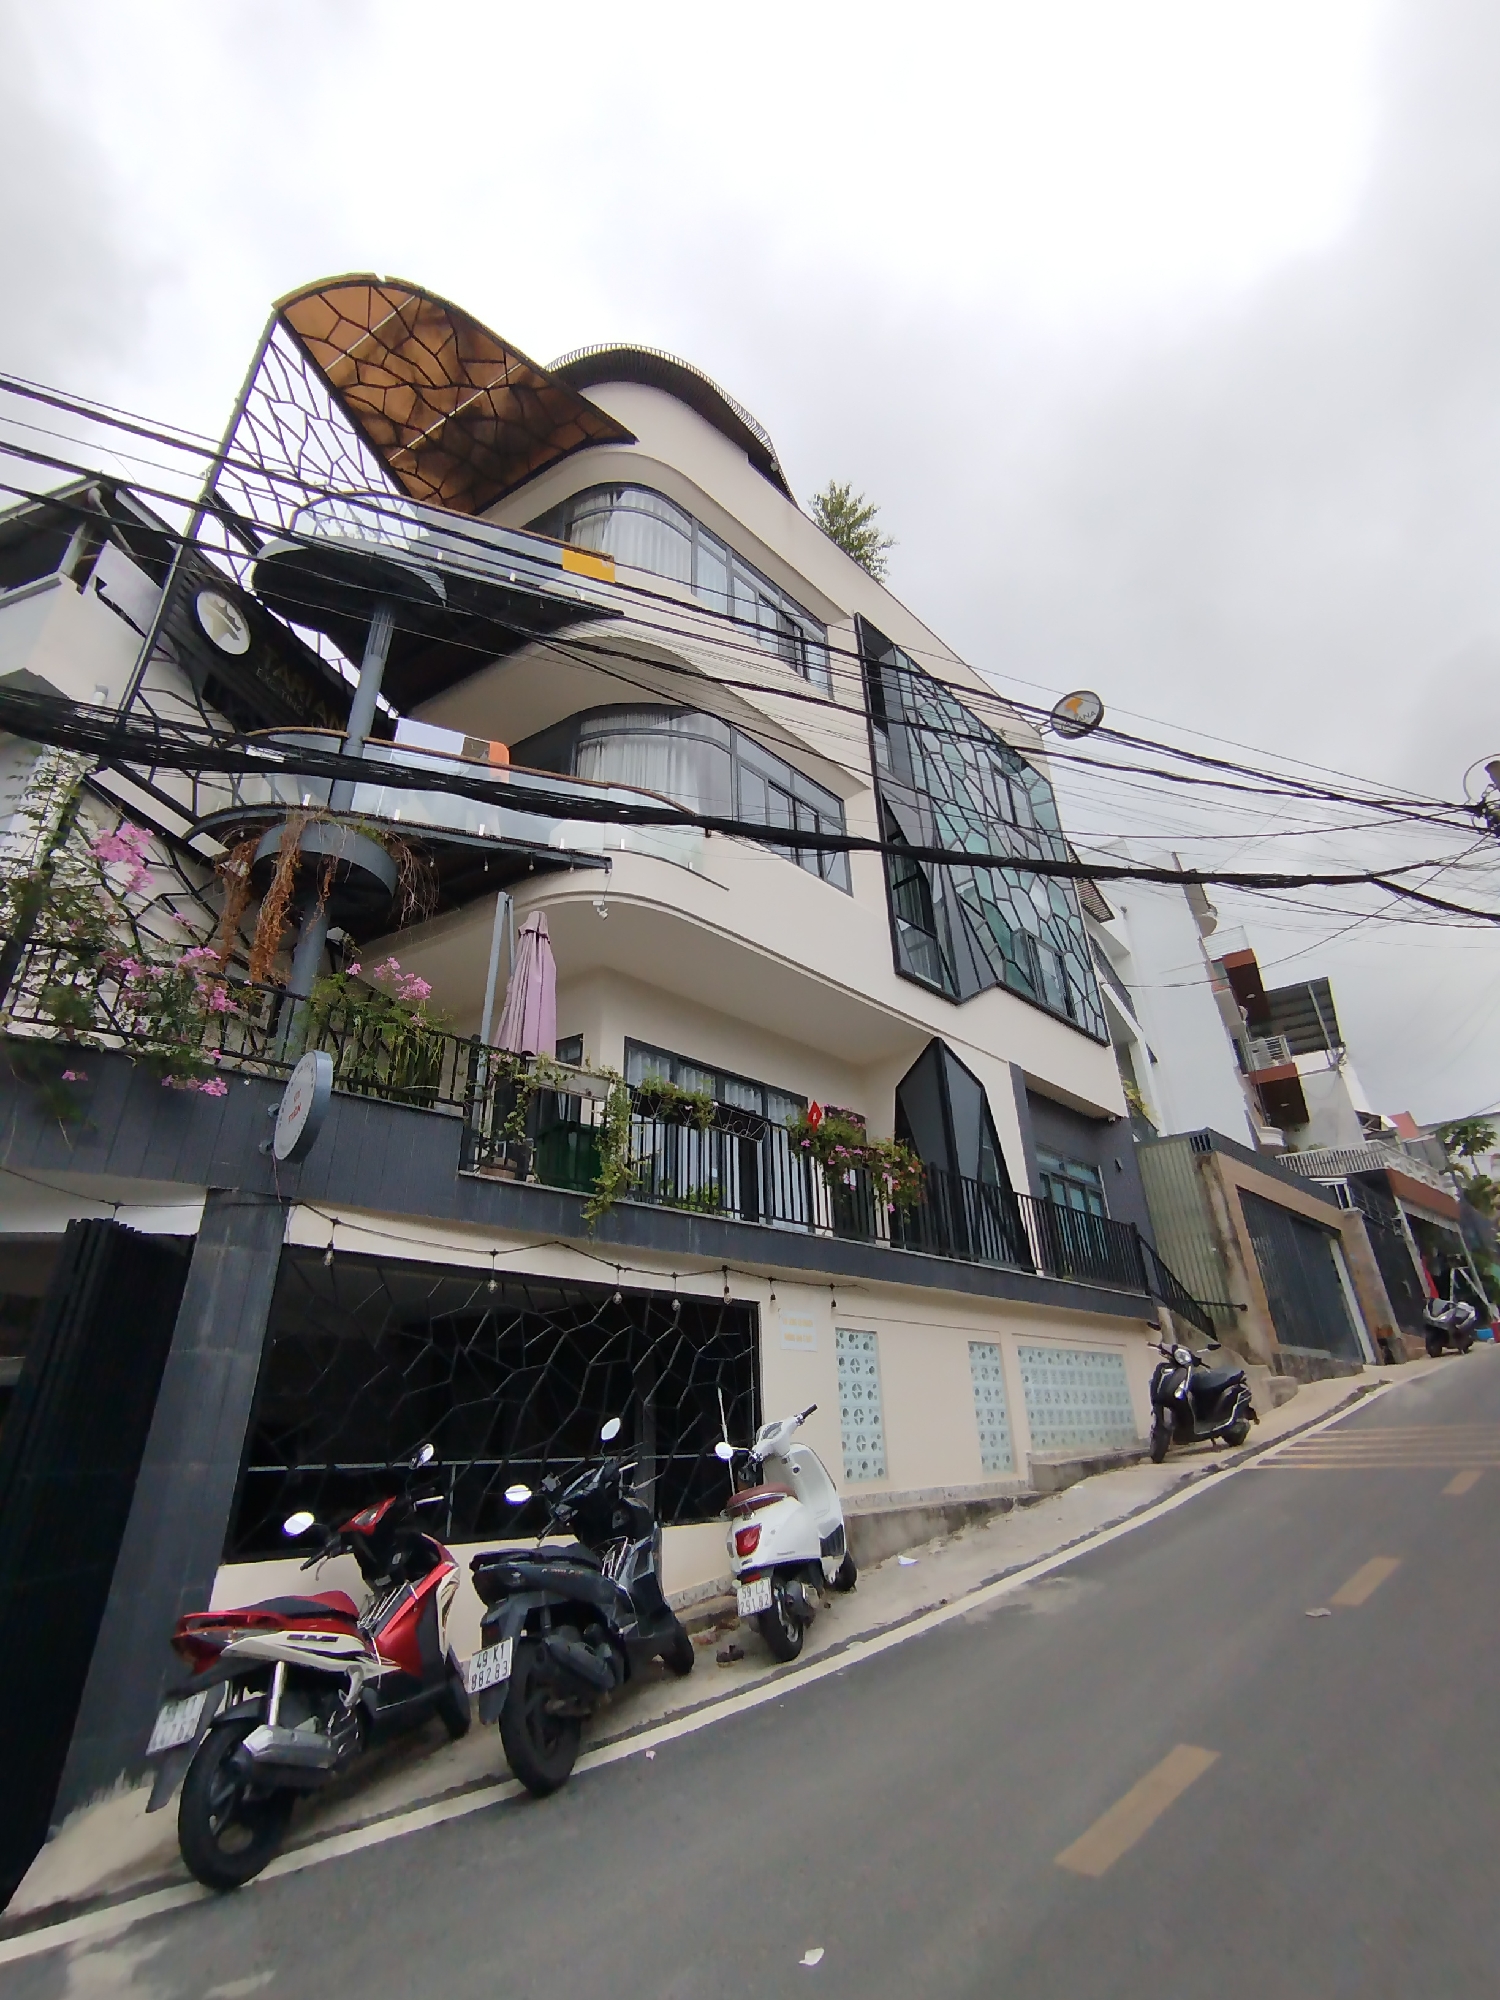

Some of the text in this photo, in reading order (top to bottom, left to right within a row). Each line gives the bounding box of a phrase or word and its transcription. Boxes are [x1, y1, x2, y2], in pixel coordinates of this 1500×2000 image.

[256, 666, 304, 717] EXCTING
[741, 1586, 751, 1599] 59
[476, 1643, 504, 1669] 49 K1
